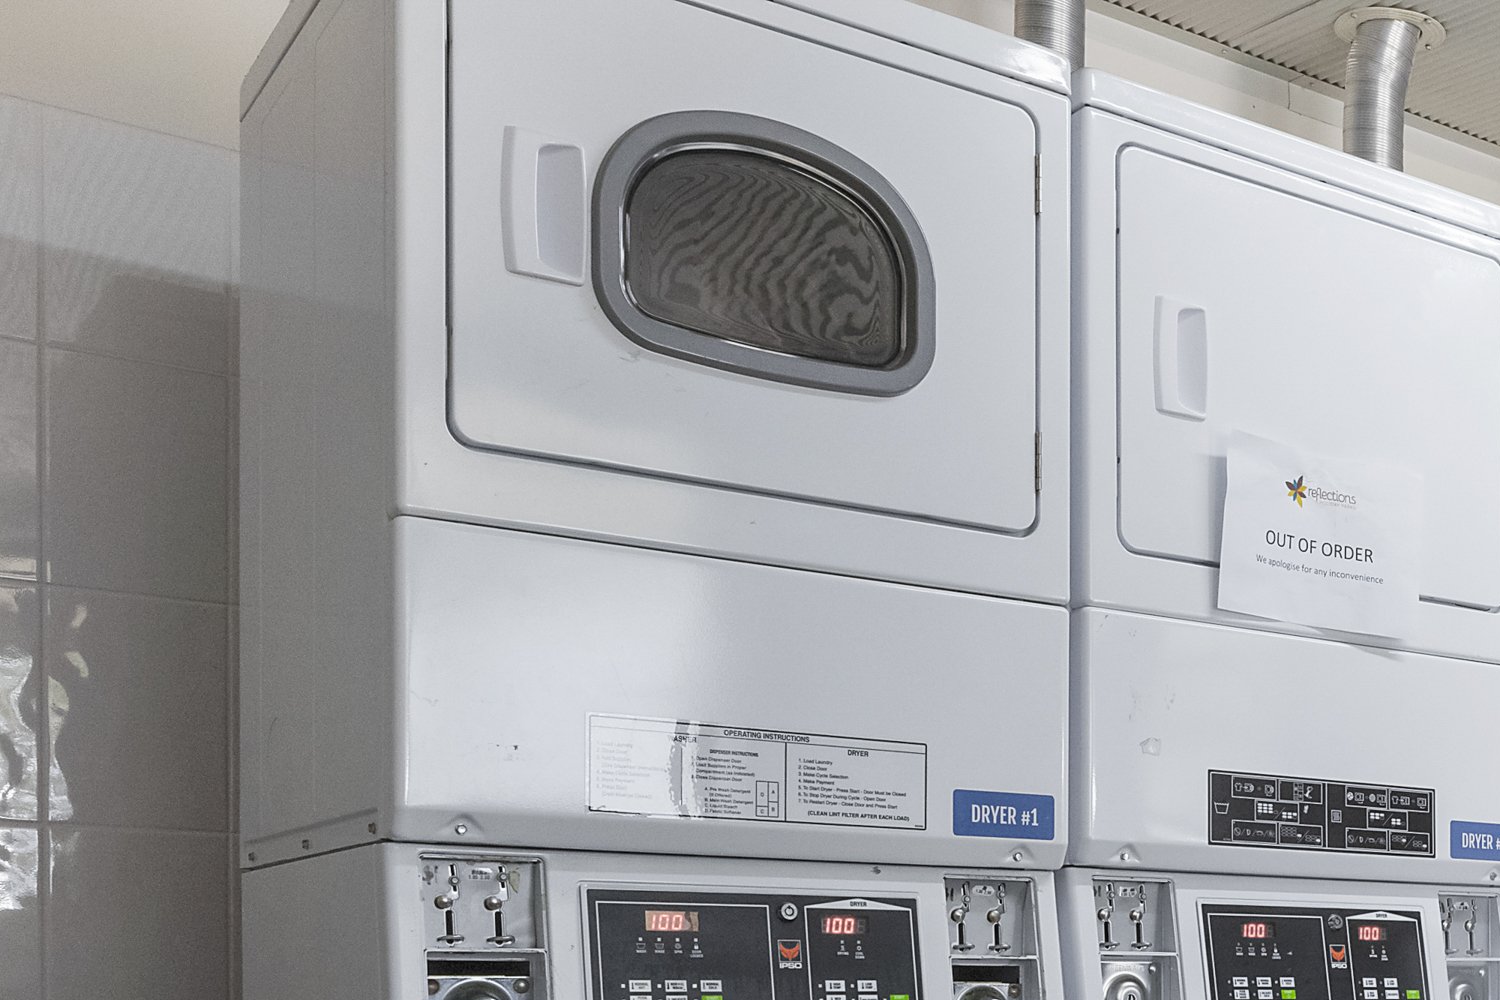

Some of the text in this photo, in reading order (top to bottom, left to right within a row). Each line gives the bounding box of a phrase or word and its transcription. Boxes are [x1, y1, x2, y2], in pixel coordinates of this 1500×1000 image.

[1308, 488, 1356, 504] reflections
[1266, 530, 1374, 563] OUT OF ORDER
[1256, 554, 1384, 584] We apologise for any inconvenience
[724, 730, 810, 742] OPERATING INSTRUCTIONS
[971, 804, 1039, 826] DRYER #1
[1462, 832, 1493, 850] DRYER
[651, 914, 684, 930] 100
[825, 918, 855, 934] 100
[1242, 924, 1265, 938] 100
[1359, 926, 1380, 941] 100
